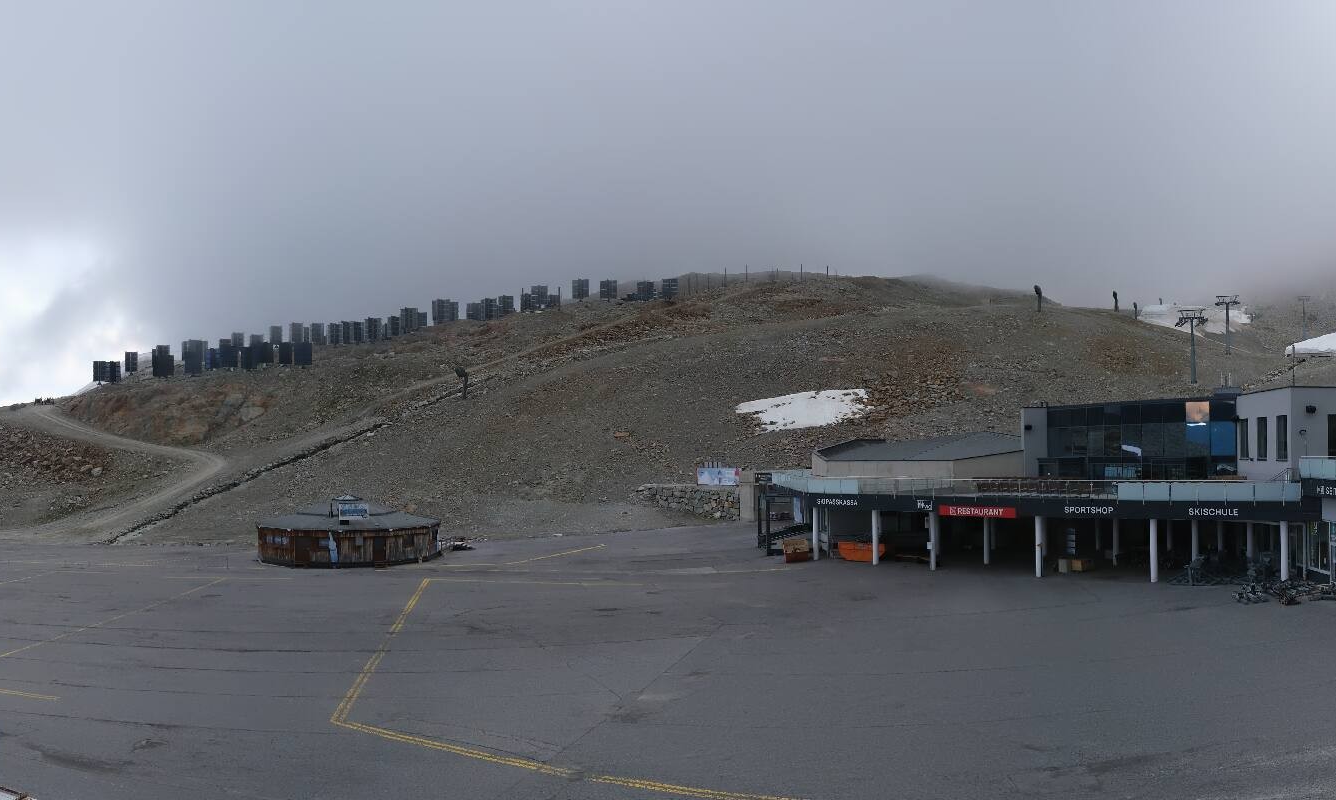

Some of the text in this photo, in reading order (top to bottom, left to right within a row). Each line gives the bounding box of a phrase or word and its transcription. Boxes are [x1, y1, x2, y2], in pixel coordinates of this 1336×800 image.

[957, 506, 1004, 516] RESTAURANT
[1064, 506, 1114, 515] SPORTSHOP
[1188, 507, 1239, 516] SKISCHULE
